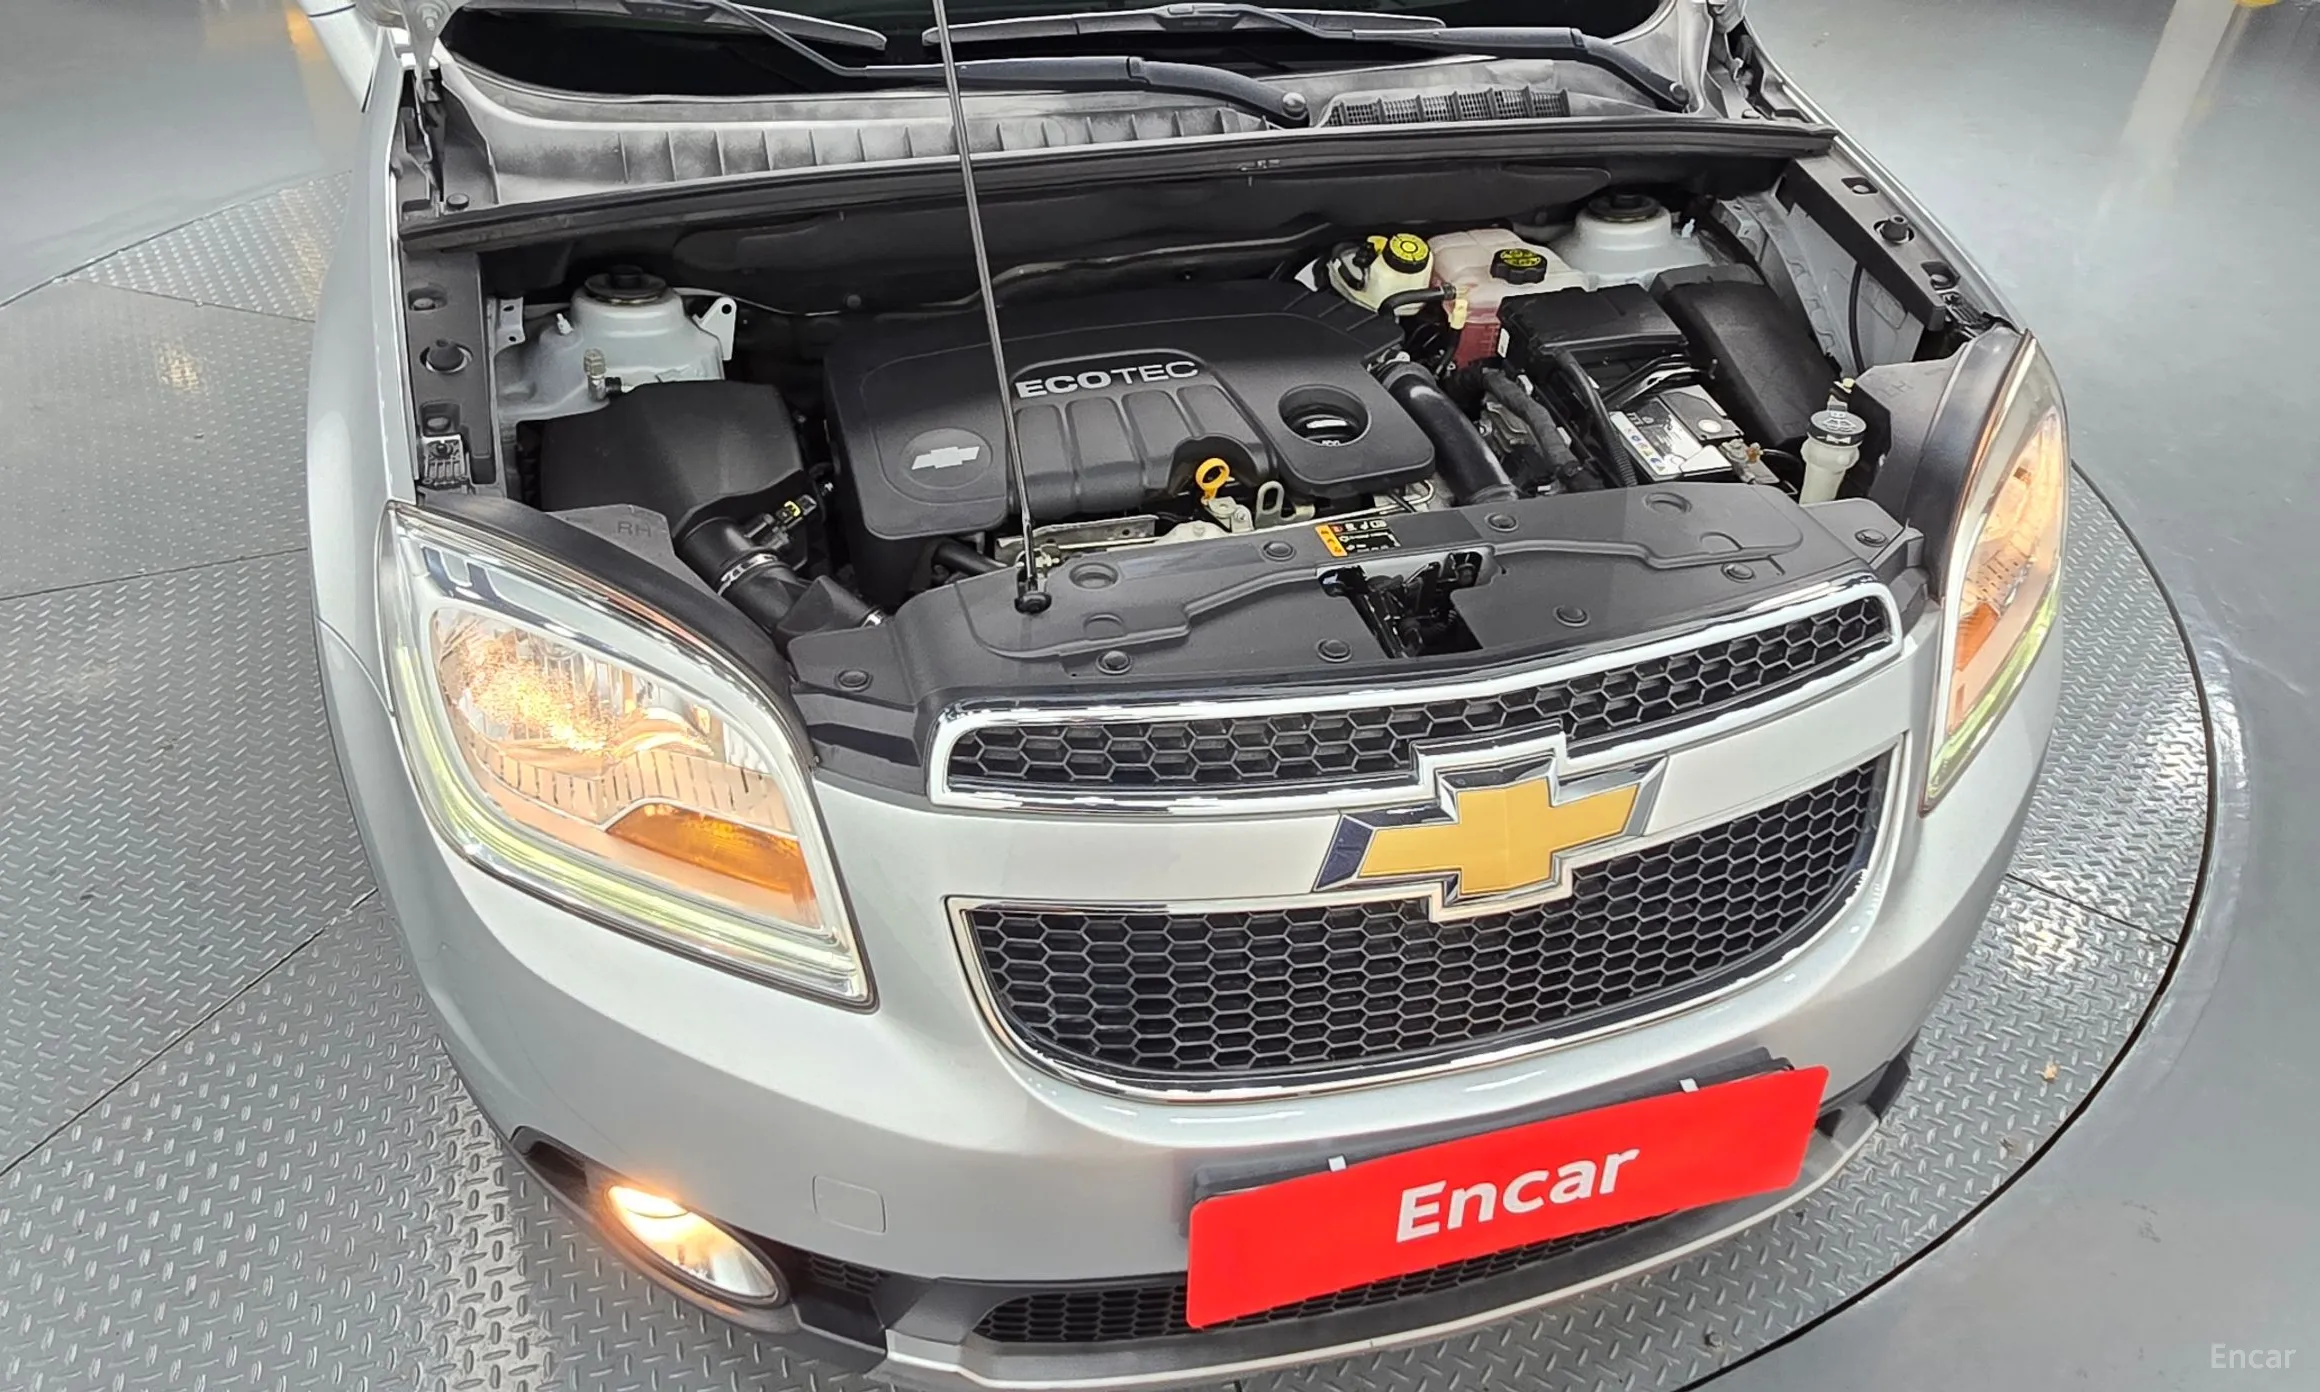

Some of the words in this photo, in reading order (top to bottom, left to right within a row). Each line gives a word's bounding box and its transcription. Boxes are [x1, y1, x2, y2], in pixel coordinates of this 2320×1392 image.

[1015, 361, 1198, 398] ECOTEC
[617, 520, 652, 538] RH
[1396, 1148, 1640, 1243] Encar
